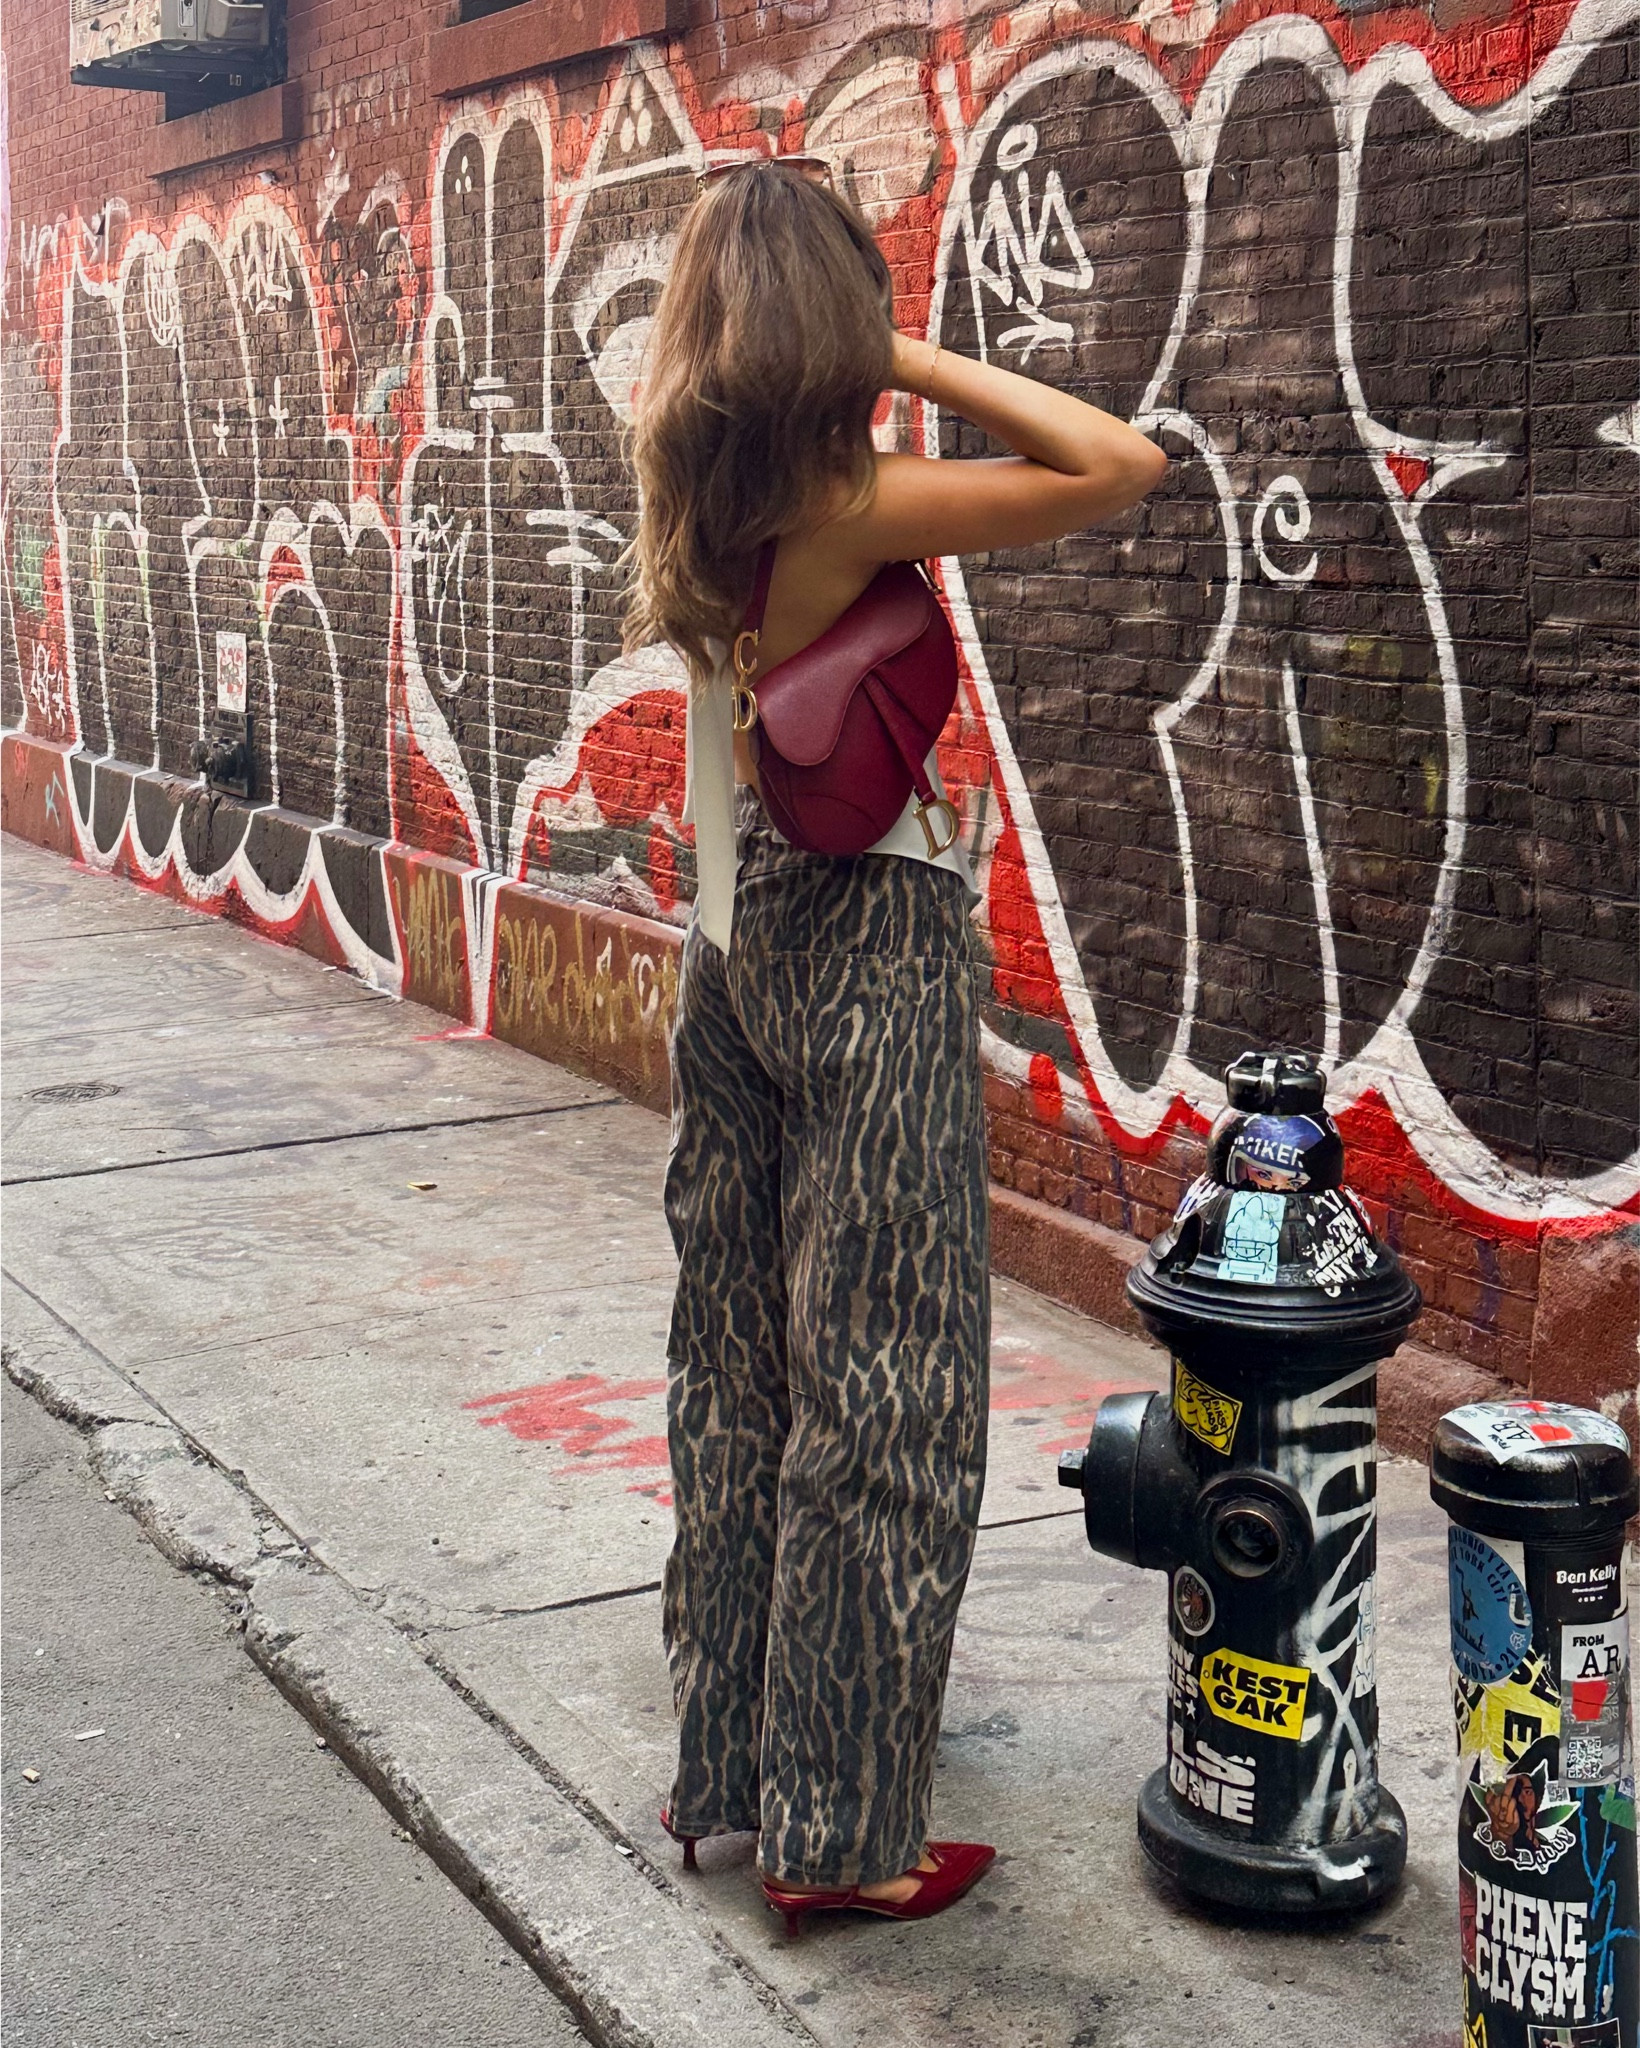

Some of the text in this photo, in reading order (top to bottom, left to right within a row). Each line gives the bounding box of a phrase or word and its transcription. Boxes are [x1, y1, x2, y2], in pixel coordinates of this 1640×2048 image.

[1556, 1564, 1618, 1584] Ben Kelly
[1572, 1634, 1605, 1647] FROM
[1212, 1658, 1307, 1705] KEST
[1213, 1685, 1291, 1727] GAK
[1475, 1877, 1588, 1963] PHENE
[1475, 1934, 1587, 2019] CLYSM
